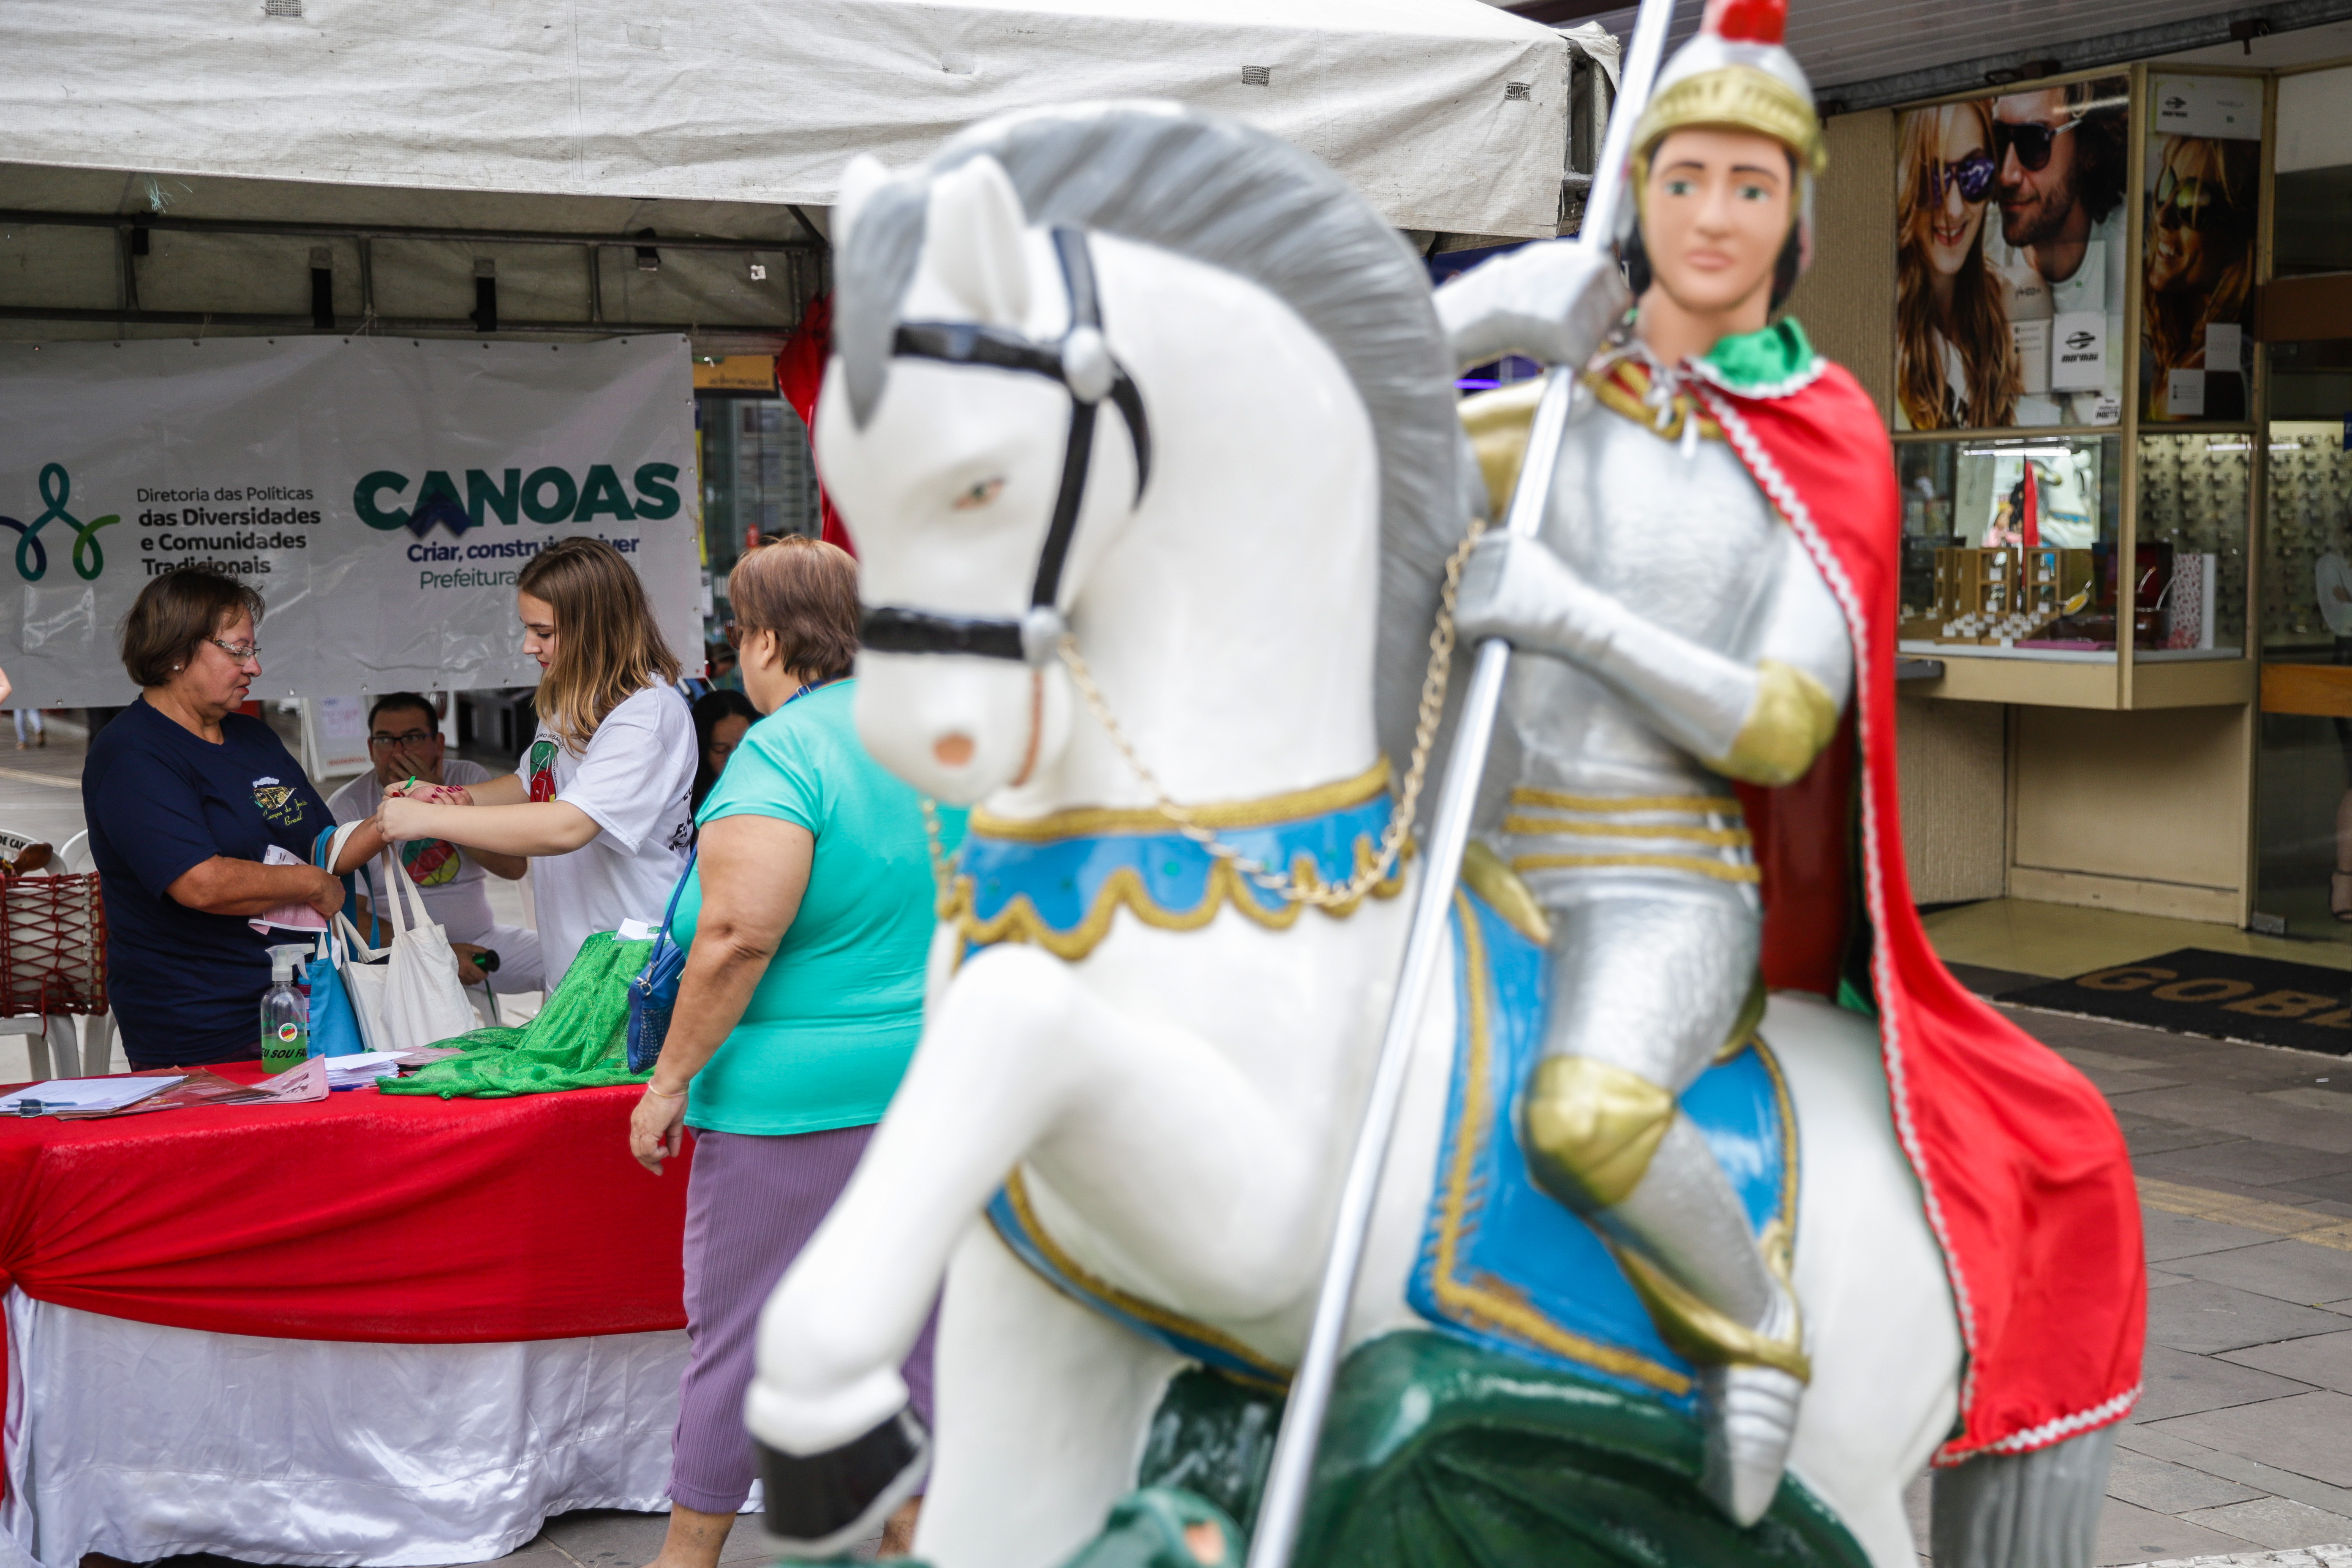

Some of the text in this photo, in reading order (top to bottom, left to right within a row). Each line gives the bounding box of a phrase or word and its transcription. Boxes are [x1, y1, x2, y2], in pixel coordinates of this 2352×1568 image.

[137, 486, 314, 503] Diretoria das Políticas
[352, 462, 681, 538] CANOAS
[138, 506, 321, 527] das Diversidades
[140, 531, 307, 551] e Comunidades
[406, 541, 463, 562] Criar,
[466, 535, 556, 560] constru
[420, 568, 517, 590] Prefeitura
[284, 804, 292, 813] do
[284, 810, 303, 826] Brasil
[270, 1049, 295, 1059] SOU
